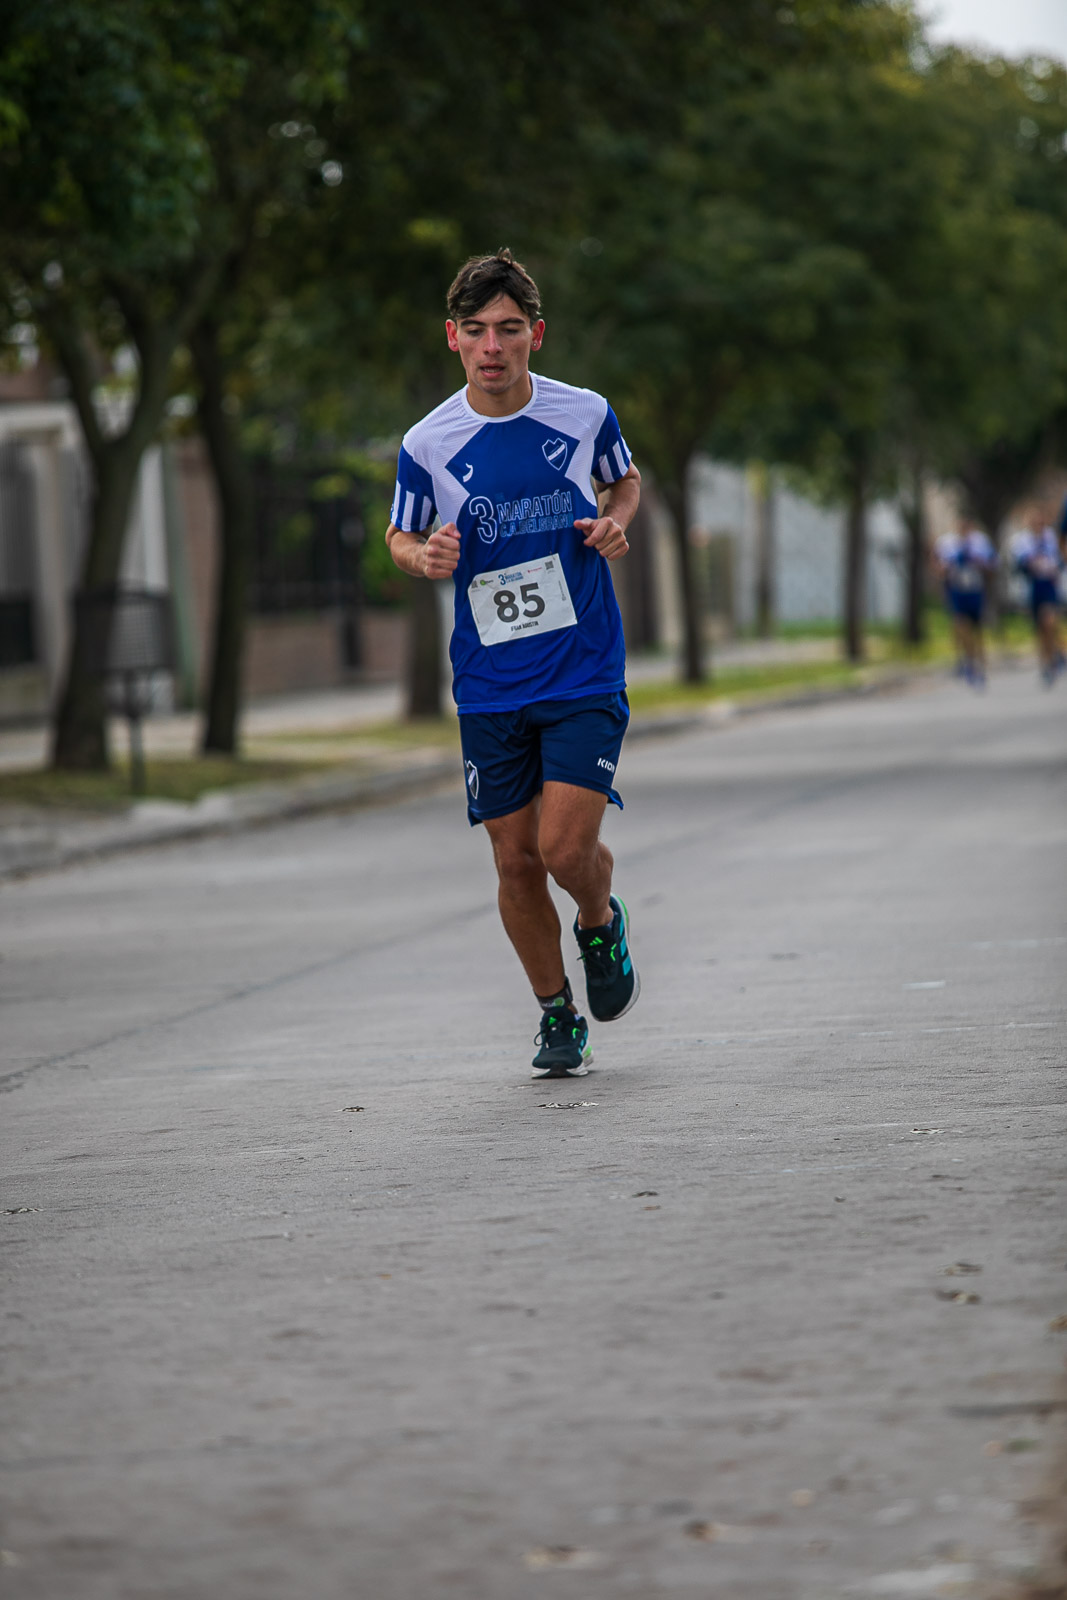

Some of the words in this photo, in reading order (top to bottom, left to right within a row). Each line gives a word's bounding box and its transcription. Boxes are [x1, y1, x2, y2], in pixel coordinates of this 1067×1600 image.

[469, 496, 497, 544] 3
[496, 489, 573, 524] MARATÓN
[493, 582, 546, 623] 85
